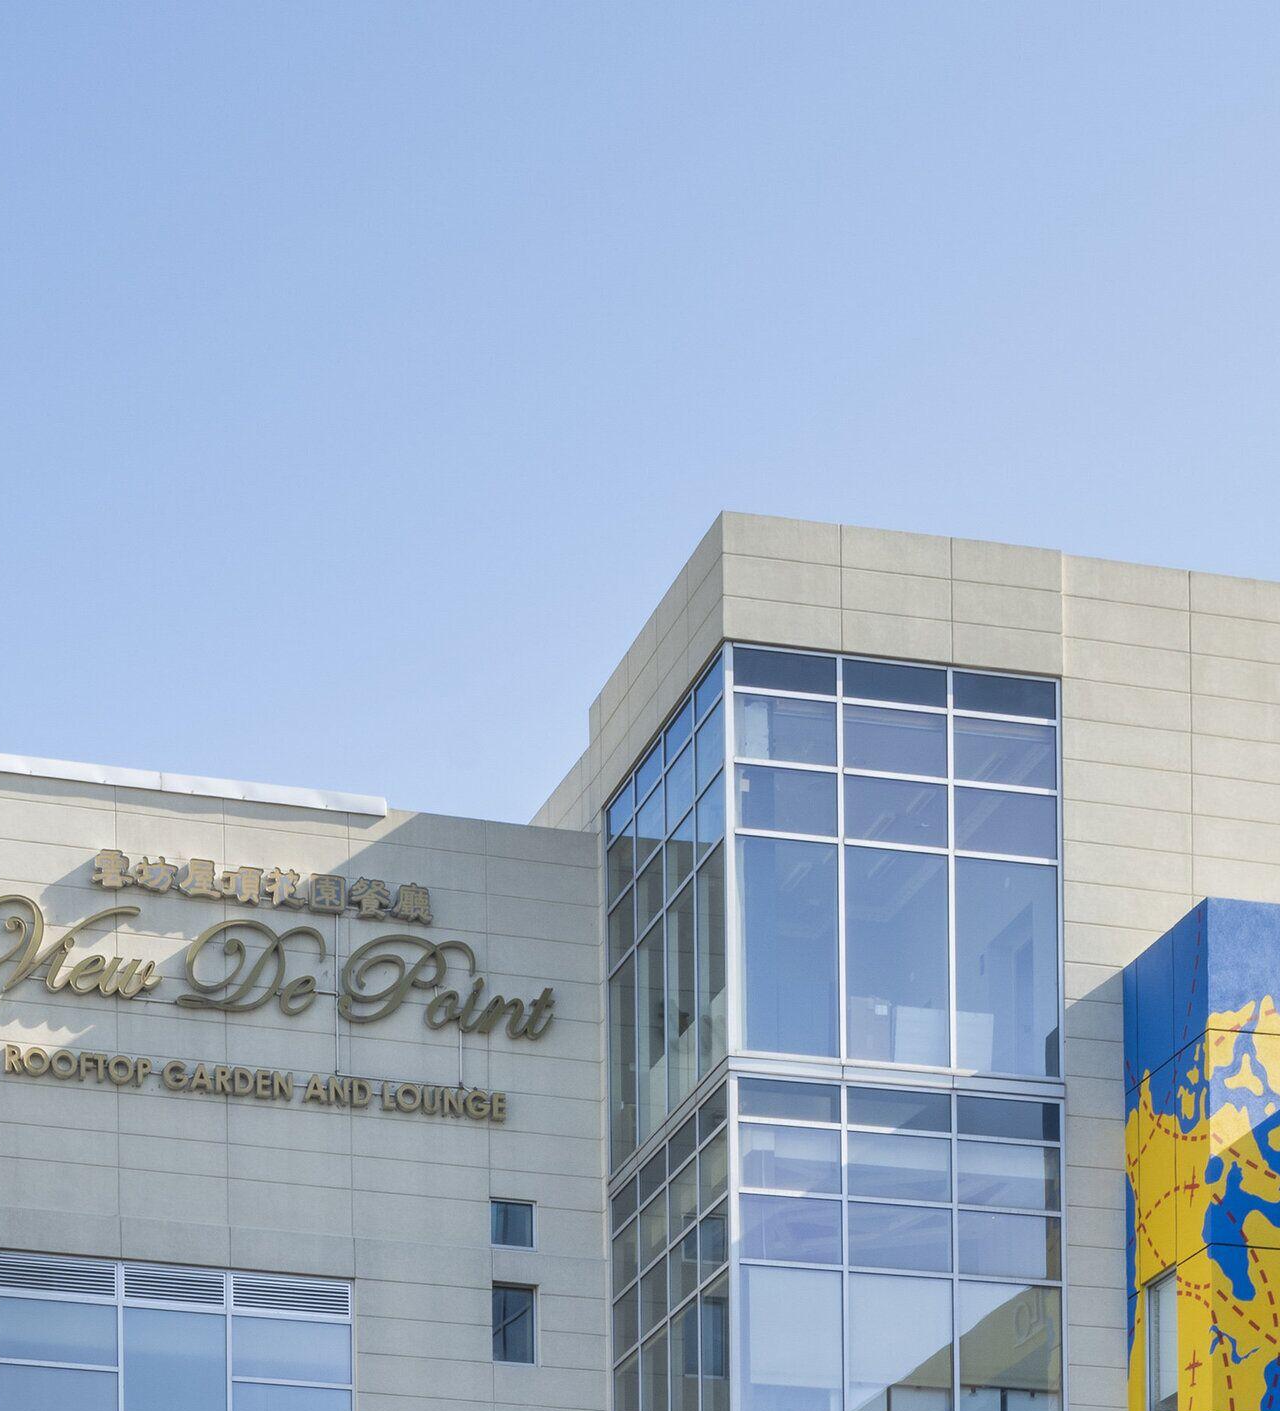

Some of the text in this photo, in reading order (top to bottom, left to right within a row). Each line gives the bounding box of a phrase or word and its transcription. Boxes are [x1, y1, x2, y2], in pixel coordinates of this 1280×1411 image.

[175, 919, 326, 1017] De
[337, 934, 557, 1041] Point
[4, 1044, 508, 1123] ROOFTOP GARDEN AND LOUNGE
